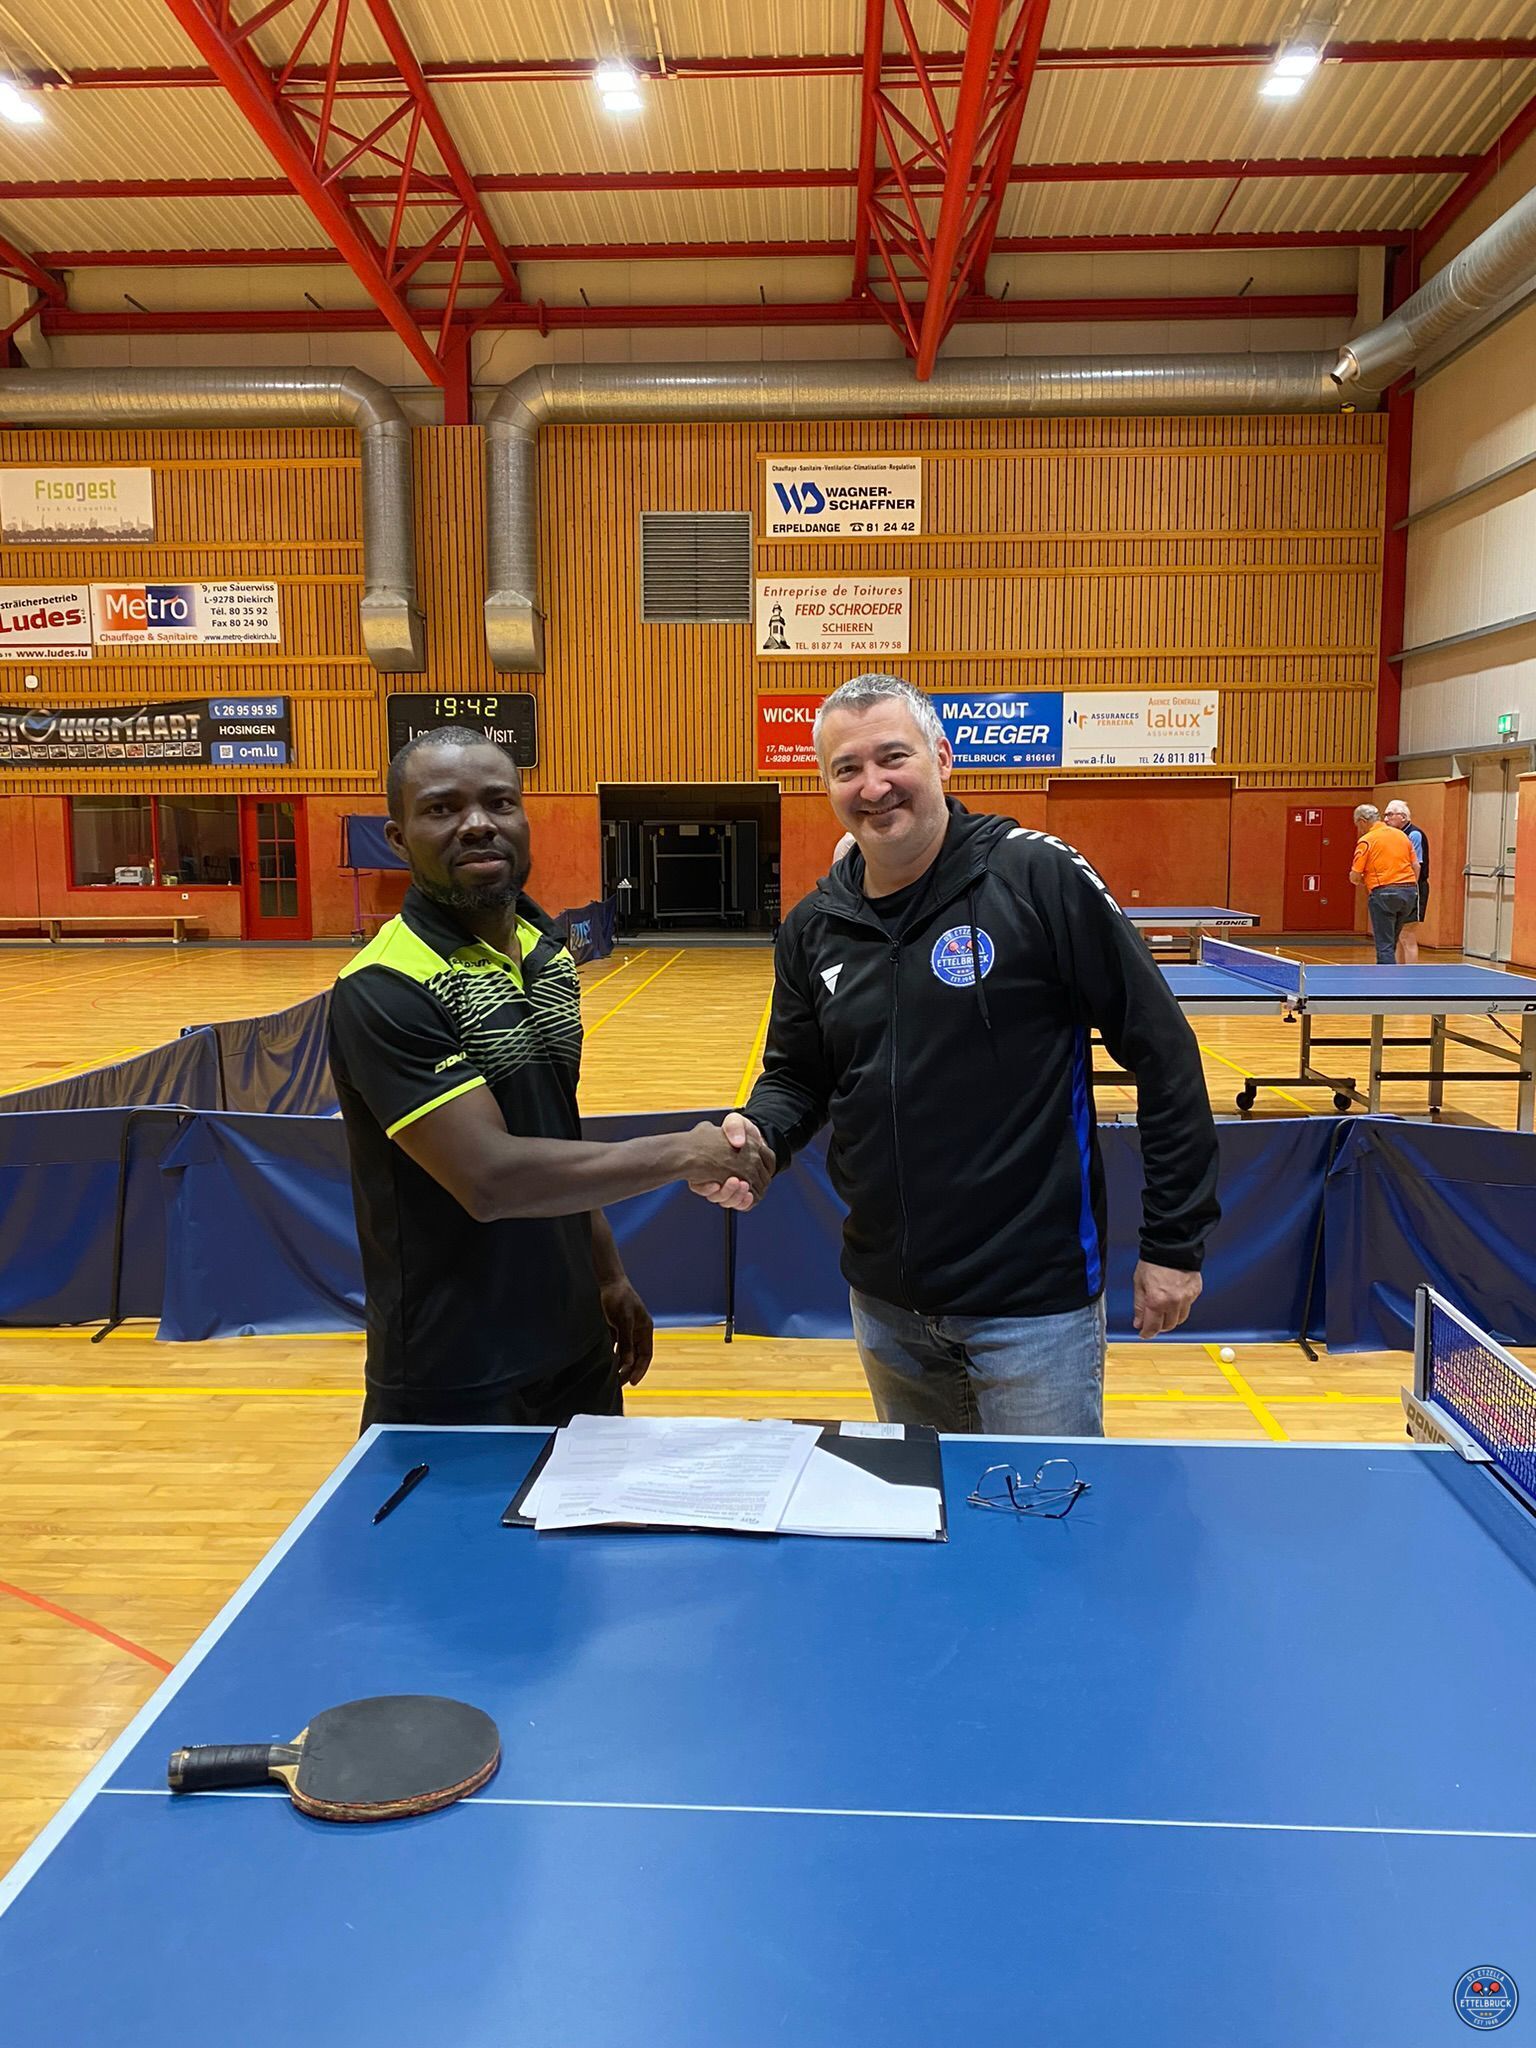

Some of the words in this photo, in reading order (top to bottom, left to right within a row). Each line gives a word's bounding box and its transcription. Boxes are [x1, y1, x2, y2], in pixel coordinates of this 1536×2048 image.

[35, 479, 117, 501] Fisogest
[825, 486, 892, 498] WAGNER-
[829, 499, 915, 511] SCHAFFNER
[773, 523, 841, 533] ERPELDANGE
[866, 523, 879, 532] 81
[884, 522, 898, 532] 24
[901, 522, 915, 532] 42
[763, 585, 828, 600] Entreprise
[833, 584, 848, 596] de
[854, 584, 903, 596] Toitures
[204, 595, 235, 604] L-9278
[237, 595, 274, 603] Diekirch
[106, 593, 188, 620] Metro
[229, 607, 241, 615] 80
[243, 607, 254, 615] 35
[256, 607, 268, 615] 92
[795, 603, 825, 616] FERD
[828, 602, 903, 616] SCHROEDER
[212, 619, 228, 627] Fax
[229, 619, 241, 627] 80
[243, 619, 254, 627] 24
[256, 618, 268, 627] 90
[822, 622, 874, 633] SCHIEREN
[100, 633, 145, 642] Chauffage
[147, 633, 155, 641] &
[157, 632, 198, 641] Sanitaire
[795, 642, 810, 650] TEL.
[811, 642, 820, 650] 81
[821, 642, 831, 650] 87
[833, 642, 843, 650] 74
[851, 642, 867, 650] FAX
[892, 641, 902, 649] 58
[16, 649, 88, 658] www.ludes.lu
[222, 705, 235, 716] 26
[237, 705, 249, 716] 95
[251, 705, 263, 715] 95
[265, 704, 278, 715] 95
[435, 697, 498, 717] 19:42
[942, 702, 1029, 719] MAZOUT
[1147, 709, 1201, 728] lalux
[219, 725, 276, 735] HOSINGEN
[955, 724, 1050, 745] PLEGER
[239, 743, 278, 757] o-m.lu
[778, 744, 794, 753] Rue
[1025, 753, 1056, 762] 816161
[1139, 756, 1149, 764] TEL
[1153, 753, 1165, 763] 26
[1168, 752, 1185, 763] 811
[1188, 752, 1206, 763] 811
